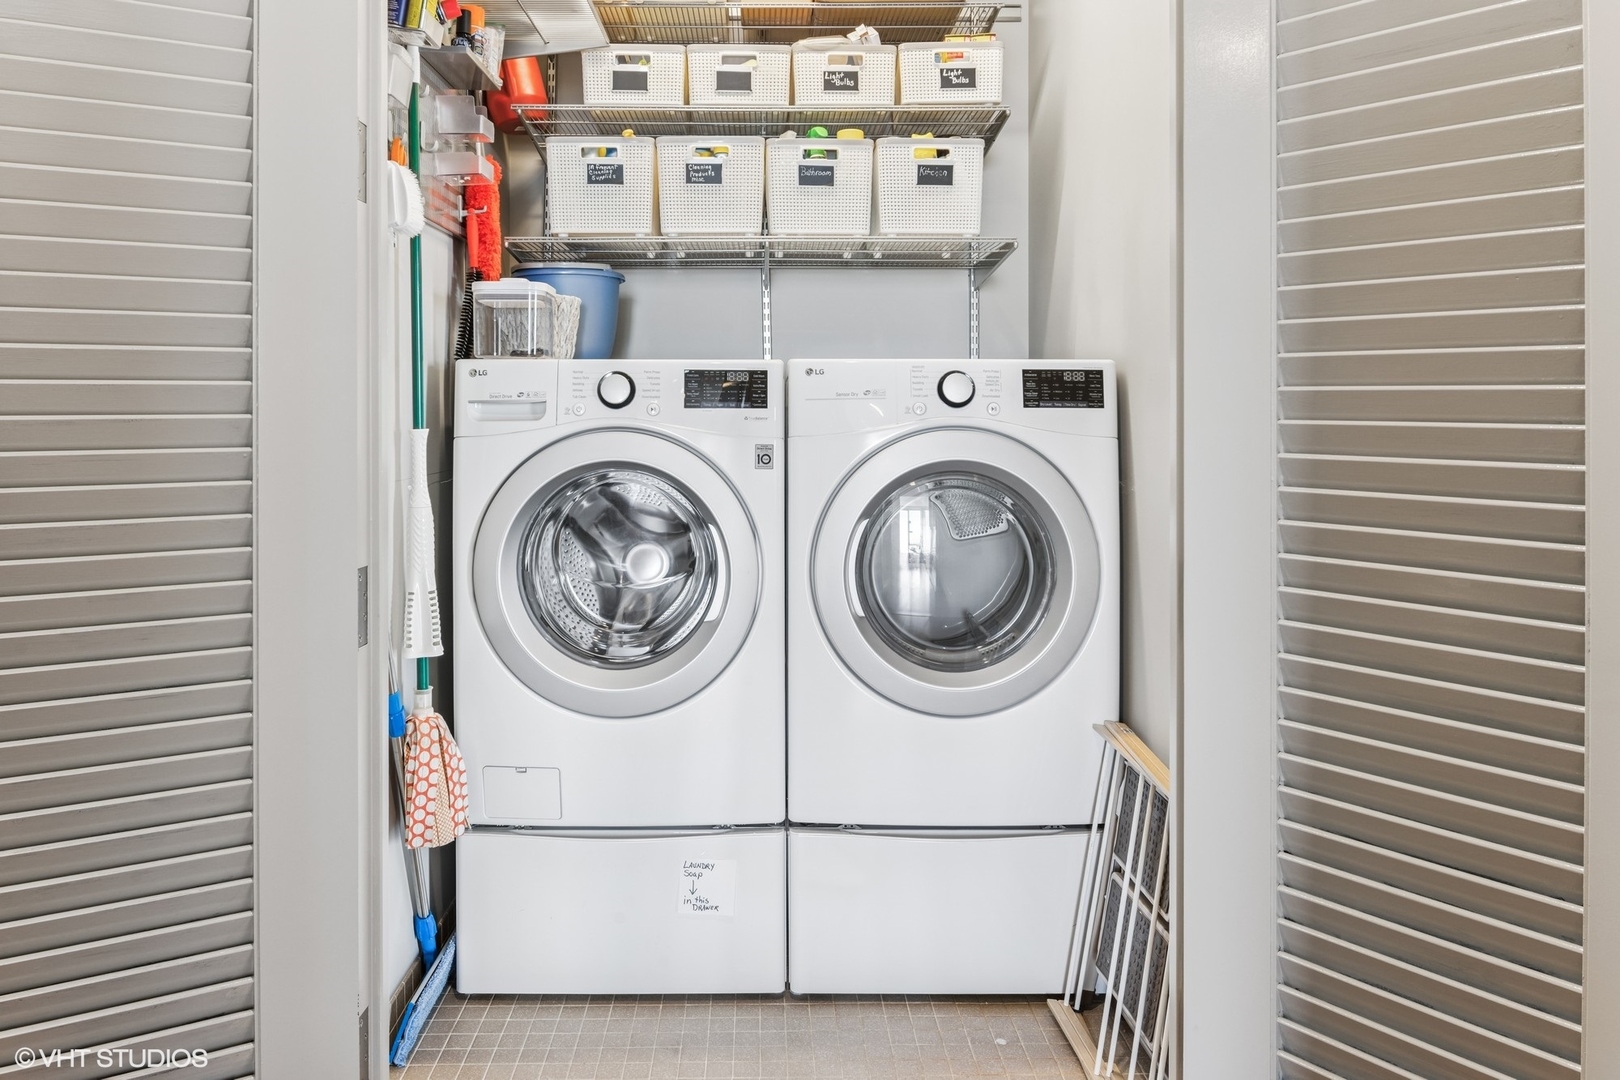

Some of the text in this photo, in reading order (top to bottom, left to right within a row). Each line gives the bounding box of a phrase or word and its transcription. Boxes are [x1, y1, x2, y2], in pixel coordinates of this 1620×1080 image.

[825, 71, 844, 83] Light
[943, 69, 962, 79] Light
[835, 77, 854, 86] Bulbs
[952, 76, 969, 84] Bulbs
[801, 166, 832, 176] Bathroom
[757, 453, 772, 465] 10
[683, 861, 715, 871] LAUNDRY
[684, 870, 703, 880] Soap
[684, 895, 710, 904] in this
[692, 904, 719, 912] DRAWER
